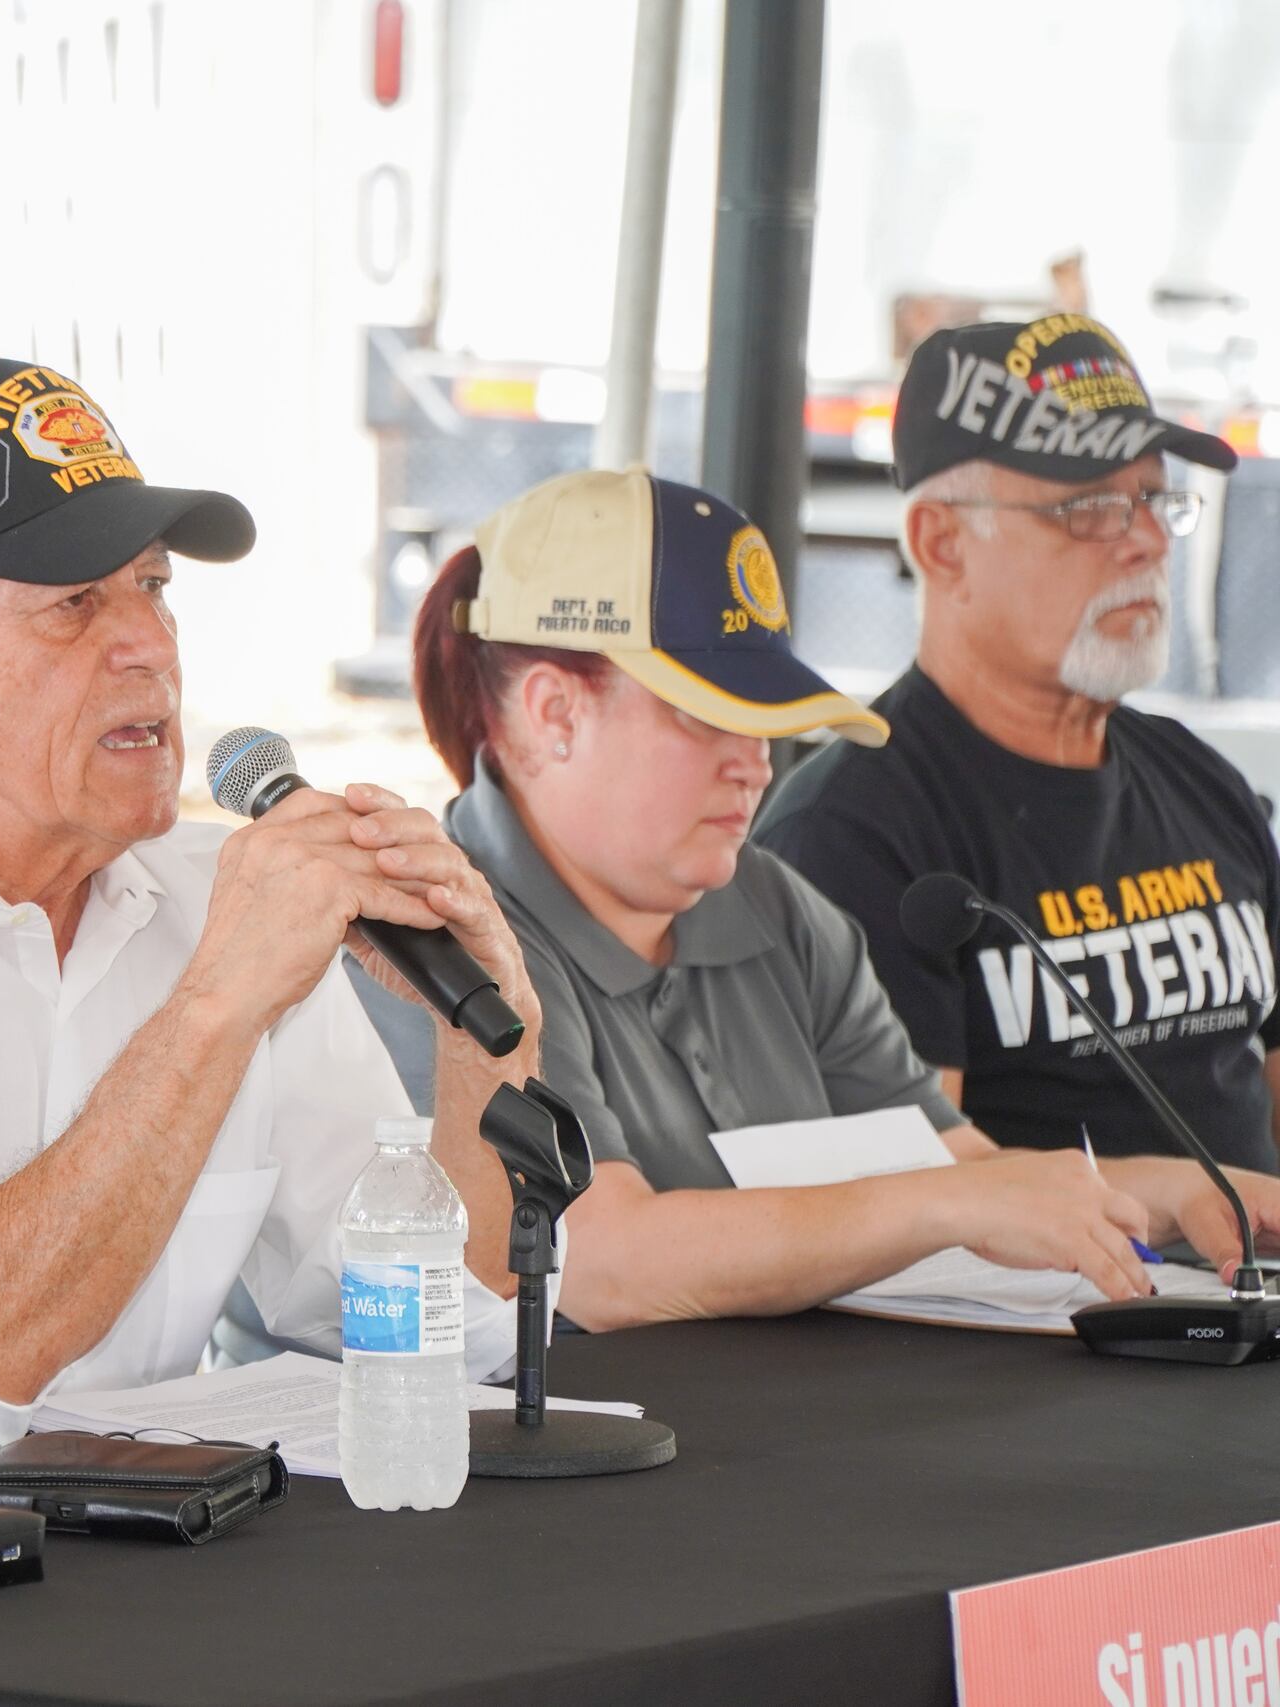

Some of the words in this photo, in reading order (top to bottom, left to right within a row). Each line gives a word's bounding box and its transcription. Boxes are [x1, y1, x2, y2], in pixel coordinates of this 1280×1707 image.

[936, 347, 1167, 460] VETERAN
[552, 599, 592, 616] DEPT.
[597, 601, 614, 616] DE
[537, 616, 589, 632] PUERTO
[594, 618, 631, 634] RICO
[1038, 884, 1118, 938] U.S.
[1117, 860, 1223, 924] ARMY
[1179, 1004, 1249, 1037] FREEDOM
[352, 1296, 407, 1318] Water
[1187, 1328, 1224, 1339] PODIO
[1098, 1632, 1148, 1707] Si
